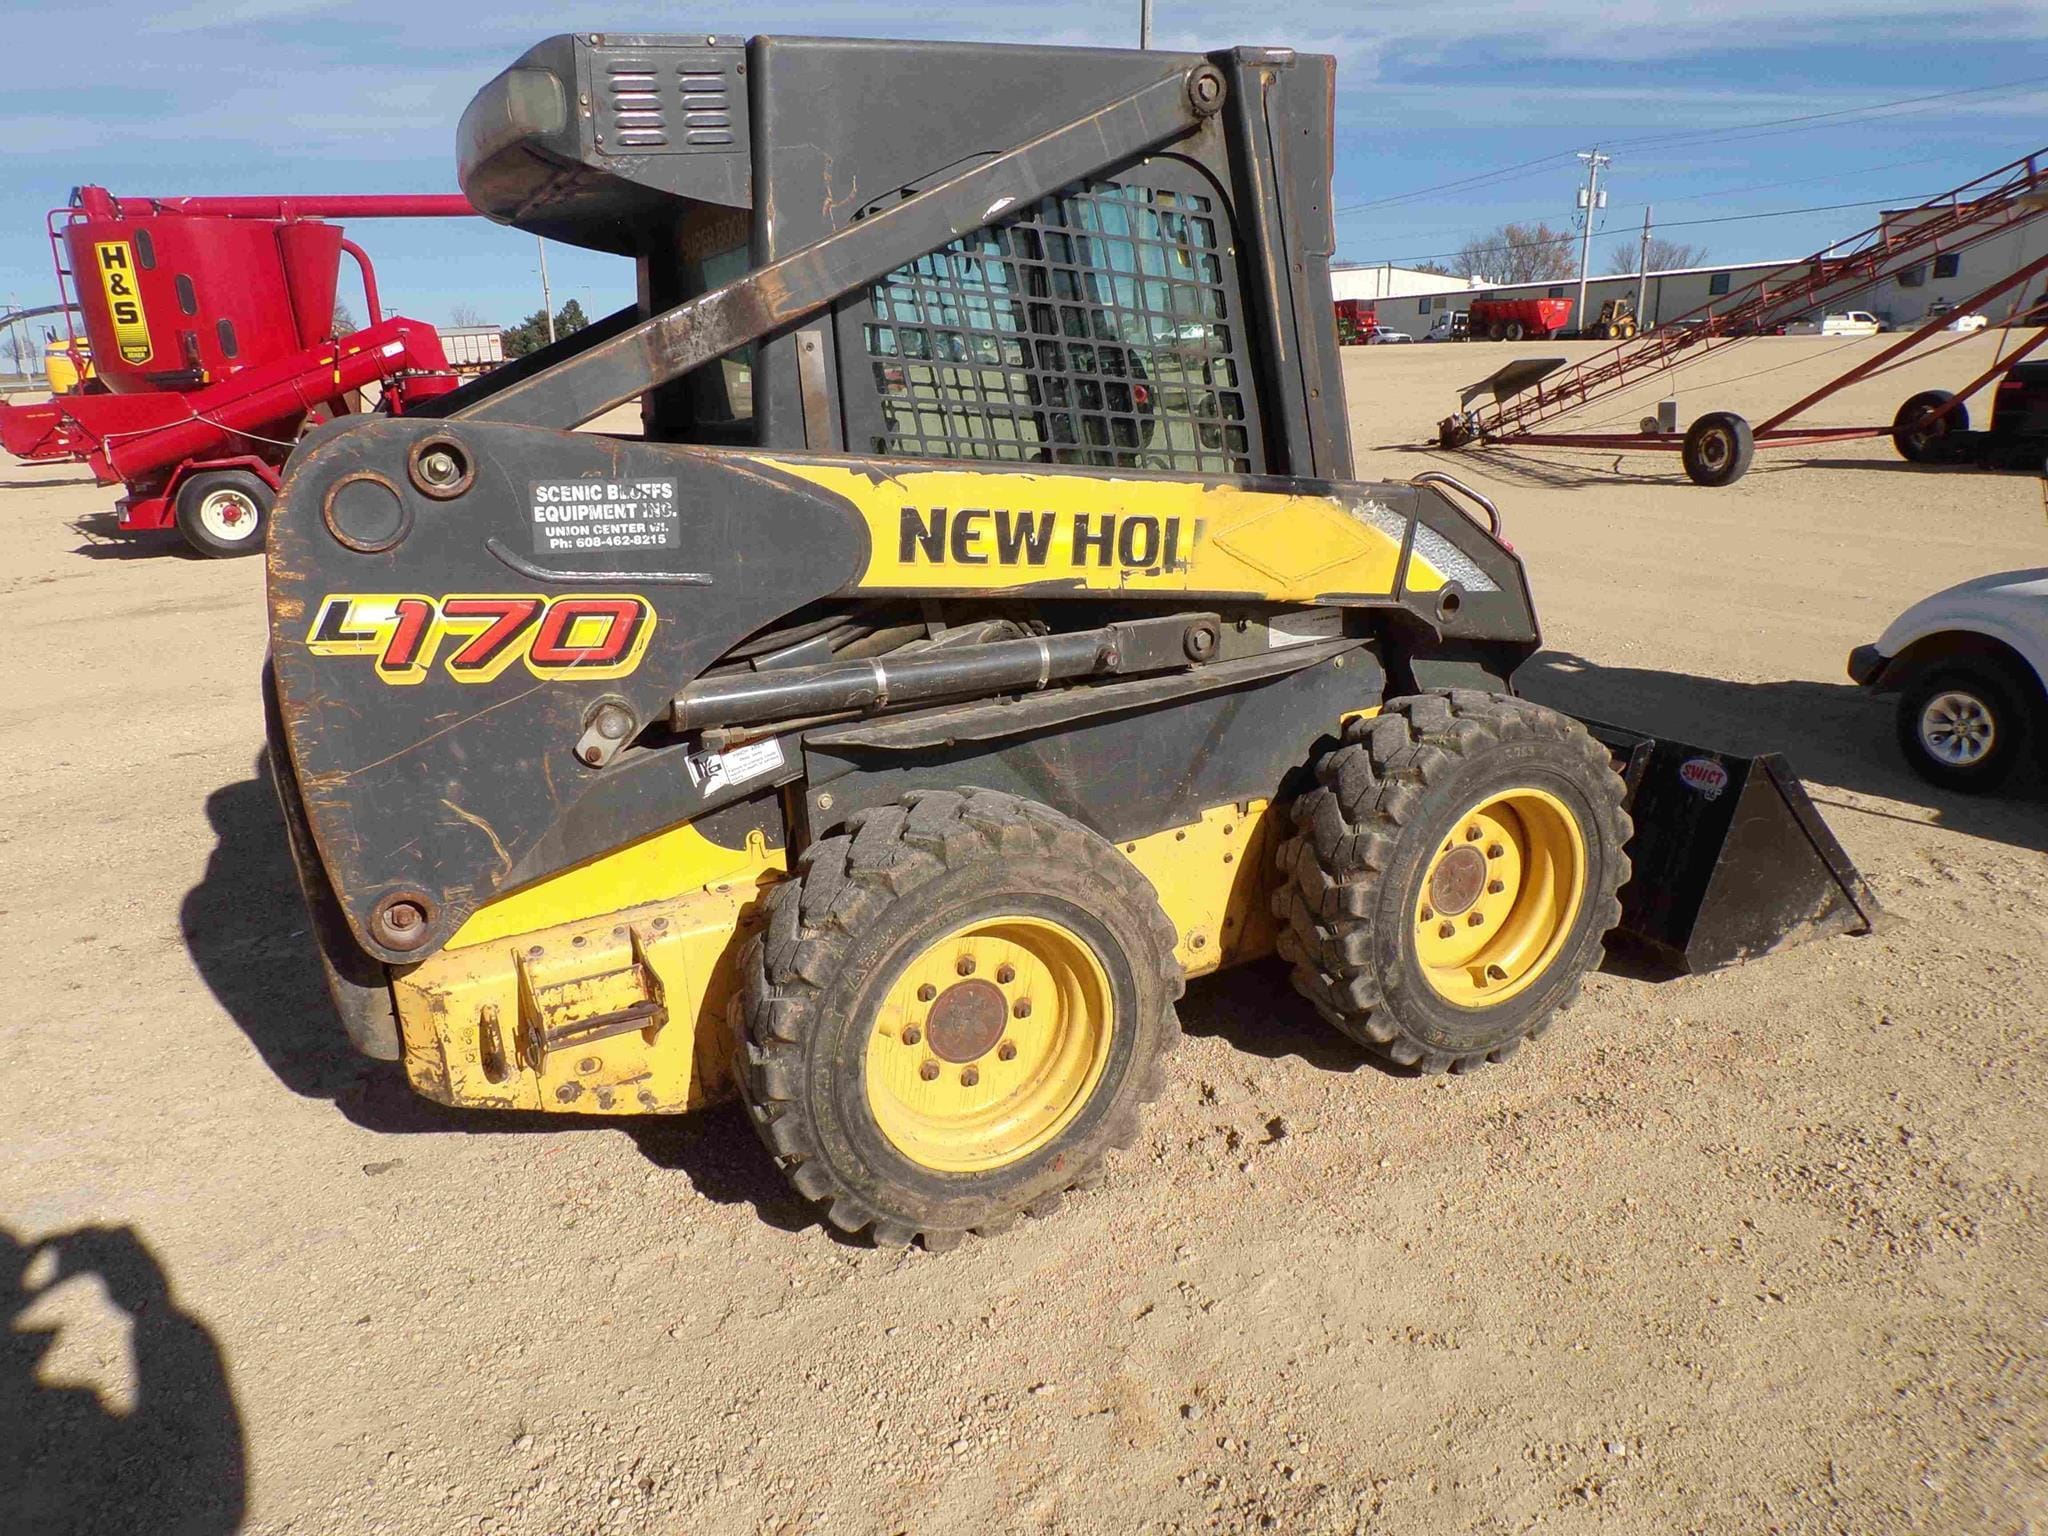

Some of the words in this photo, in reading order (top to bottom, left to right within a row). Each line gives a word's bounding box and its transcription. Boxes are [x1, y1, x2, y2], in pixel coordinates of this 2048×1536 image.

[536, 485, 602, 502] SCENIC
[607, 483, 673, 500] BLUFFS
[534, 503, 637, 522] EQUIPMENT
[642, 502, 677, 518] INC.
[545, 525, 590, 537] UNION
[593, 523, 646, 535] CENTER
[899, 506, 1057, 566] NEW
[550, 537, 573, 549] Ph:
[576, 534, 667, 547] 608-462-8215
